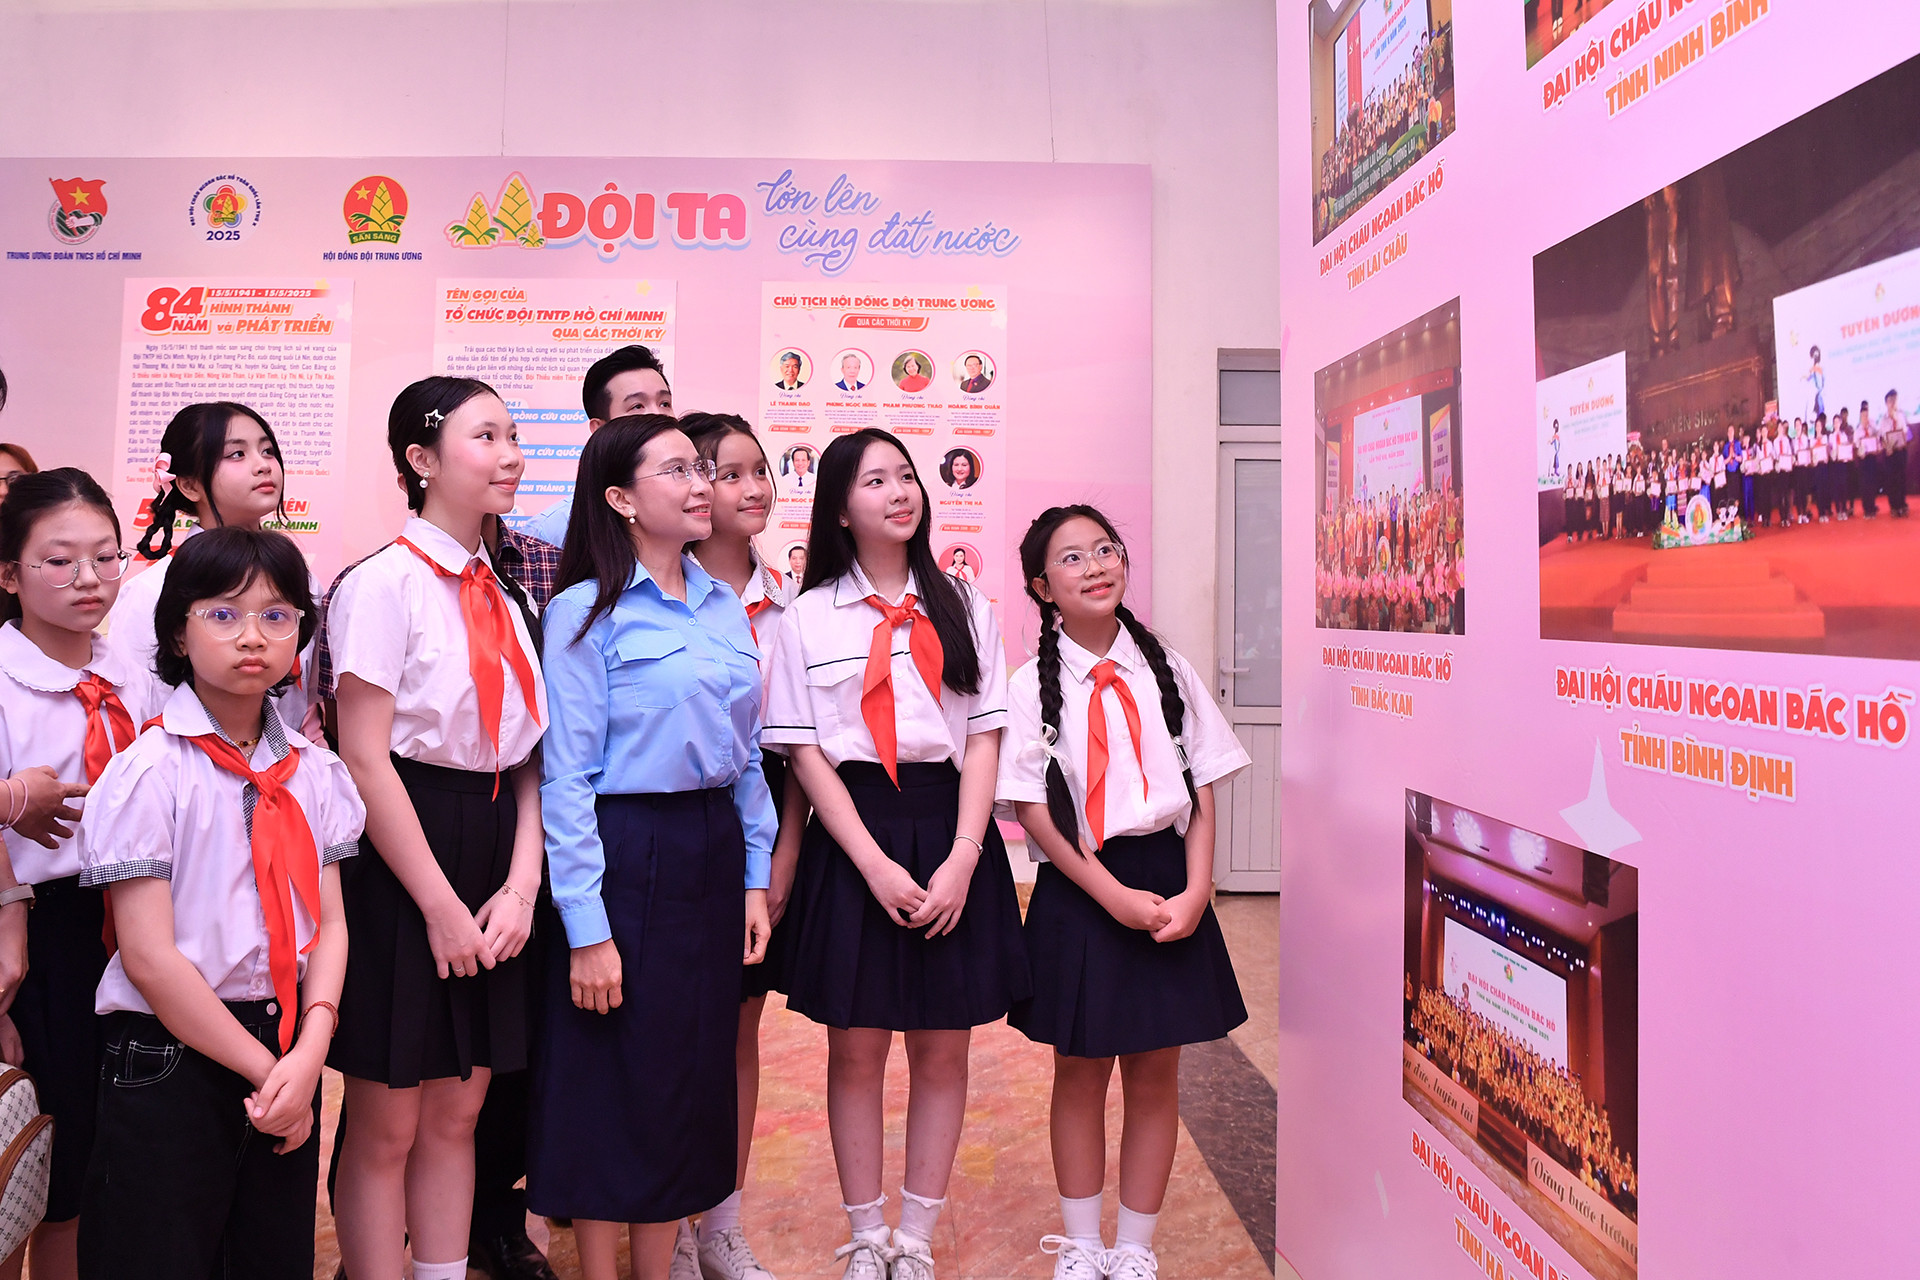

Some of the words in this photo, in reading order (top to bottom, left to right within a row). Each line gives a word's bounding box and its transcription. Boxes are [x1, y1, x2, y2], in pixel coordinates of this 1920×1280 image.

[1543, 66, 1570, 110] ĐẠI
[1575, 40, 1604, 87] HỘI
[1610, 2, 1662, 58] CHÁU
[1606, 72, 1648, 116] TỈNH
[1654, 24, 1704, 86] NINH
[757, 169, 818, 212] lớn
[825, 174, 878, 212] lên
[206, 230, 240, 240] 2025
[538, 182, 653, 254] ĐỘI
[667, 192, 746, 240] TA
[1320, 255, 1331, 276] ĐẠI
[1334, 240, 1346, 265] HỘI
[1348, 224, 1370, 254] CHÁU
[1372, 198, 1402, 238] NGOAN
[1406, 180, 1425, 212] BÁC
[1428, 158, 1444, 196] HỒ
[7, 252, 30, 260] TRUNG
[76, 252, 94, 260] TNCS
[122, 252, 142, 260] MINH
[323, 251, 335, 262] HỘI
[361, 251, 372, 262] ĐỘI
[375, 252, 399, 260] TRUNG
[780, 220, 858, 272] cùng
[869, 210, 932, 253] đất
[932, 222, 1018, 252] nước
[1368, 252, 1380, 278] LAI
[1383, 232, 1408, 266] CHÂU
[142, 287, 206, 331] 84
[210, 302, 242, 313] HÌNH
[246, 302, 291, 314] THÀNH
[446, 288, 469, 299] TÊN
[473, 290, 496, 302] GỌI
[500, 287, 524, 299] CỦA
[801, 297, 826, 310] TỊCH
[831, 296, 850, 309] HỘI
[893, 296, 914, 310] ĐỘI
[918, 298, 956, 308] TRUNG
[218, 323, 232, 332] và
[236, 317, 281, 332] PHÁT
[284, 314, 332, 332] TRIỂN
[446, 304, 464, 320] TỔ
[468, 307, 503, 320] CHỨC
[507, 308, 532, 324] ĐỘI
[537, 311, 570, 320] TNTP
[574, 306, 595, 321] HỒ
[600, 308, 622, 321] CHÍ
[625, 311, 664, 321] MINH
[857, 318, 870, 326] QUA
[1884, 305, 1920, 328] DƯƠN
[552, 328, 578, 340] QUA
[584, 326, 608, 338] CÁC
[611, 328, 641, 338] THỜI
[560, 412, 585, 420] QUỐC
[287, 522, 318, 530] MINH
[1323, 647, 1335, 669] ĐẠI
[1337, 644, 1350, 672] HỘI
[1352, 648, 1374, 671] CHÁU
[1377, 652, 1409, 676] NGOAN
[1412, 652, 1432, 679] BÁC
[1436, 652, 1453, 681] HỒ
[1372, 683, 1389, 711] BẮC
[1392, 692, 1412, 719] KẠN
[1556, 669, 1585, 704] ĐẠI
[1590, 666, 1621, 709] HỘI
[1627, 674, 1682, 712] CHÁU
[1690, 683, 1778, 726] NGOAN
[1786, 688, 1846, 736] BÁC
[1858, 692, 1912, 743] HỒ
[1620, 724, 1666, 769] TỈNH
[1672, 737, 1724, 782] BÌNH
[1730, 752, 1793, 797] ĐỊNH
[1412, 1132, 1430, 1167] ĐẠI
[1434, 1154, 1452, 1190] HỘI
[1456, 1176, 1489, 1226] CHÁU
[1493, 1210, 1543, 1280] NGOAN
[1455, 1217, 1482, 1267] TỈNH
